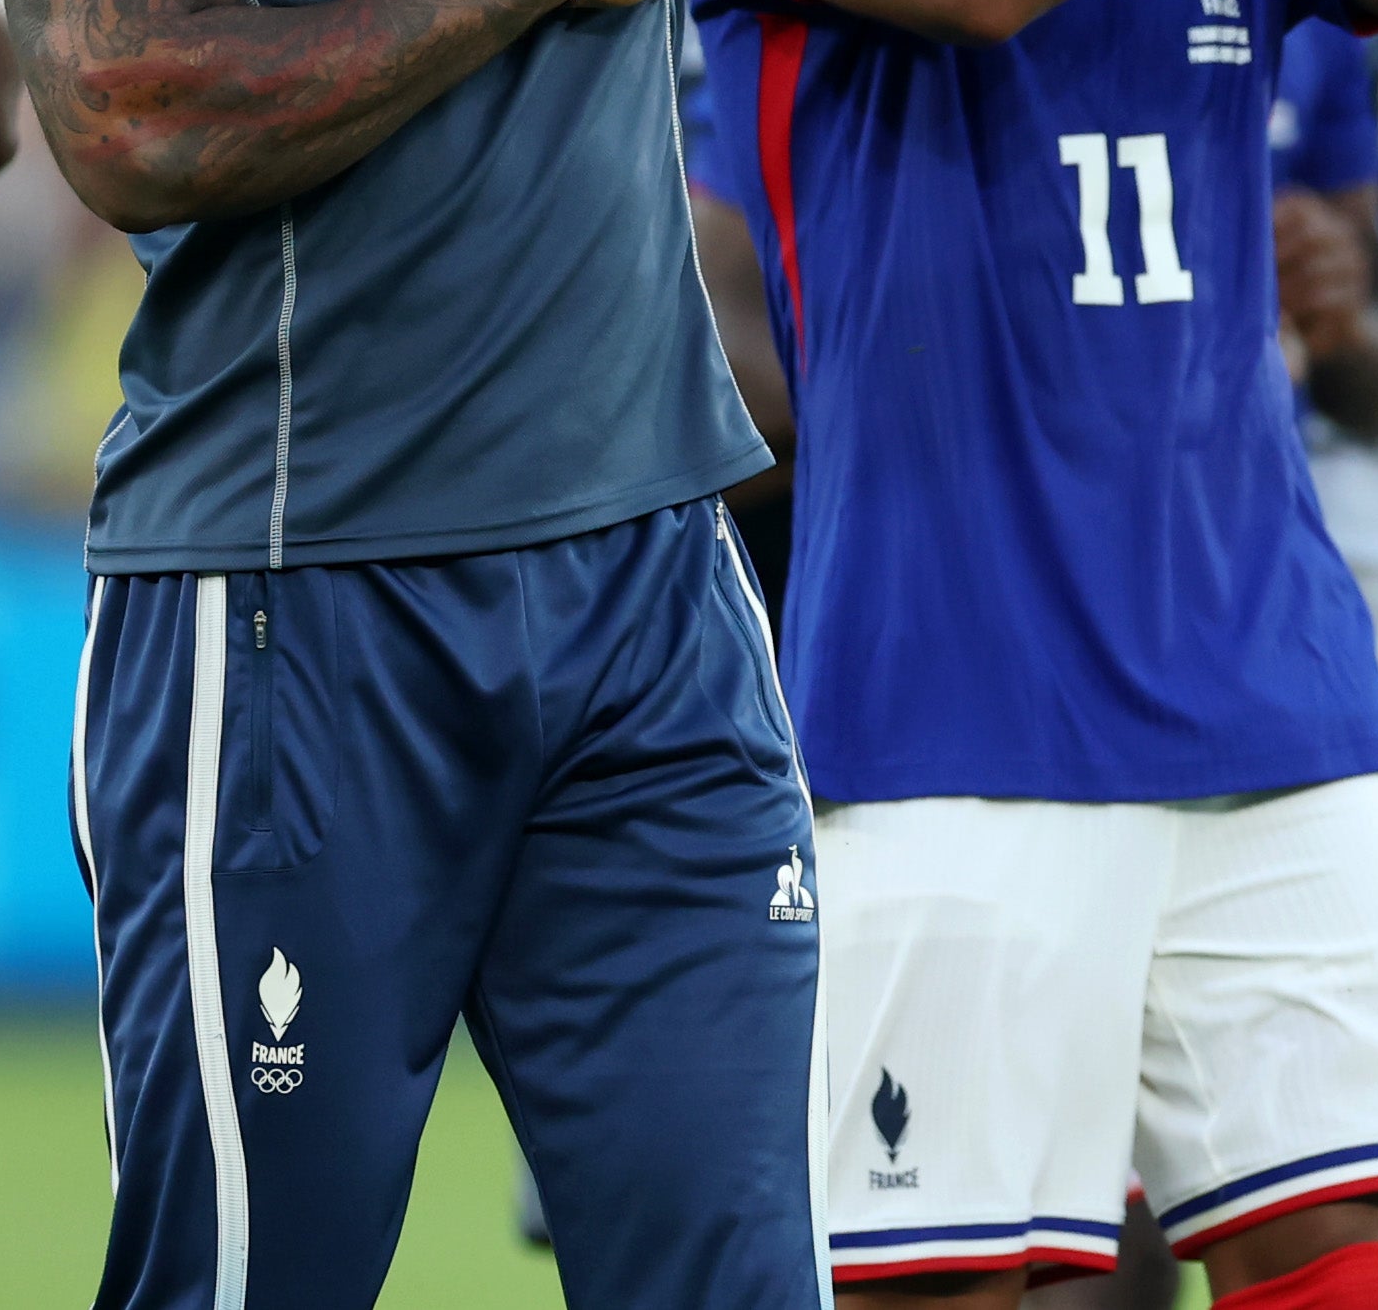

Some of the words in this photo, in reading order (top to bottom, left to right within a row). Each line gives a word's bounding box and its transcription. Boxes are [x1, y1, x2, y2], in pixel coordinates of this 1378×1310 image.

[1058, 132, 1194, 306] 11
[769, 906, 780, 921] LE
[251, 1041, 305, 1065] FRANCE
[868, 1166, 920, 1191] FRANCE
